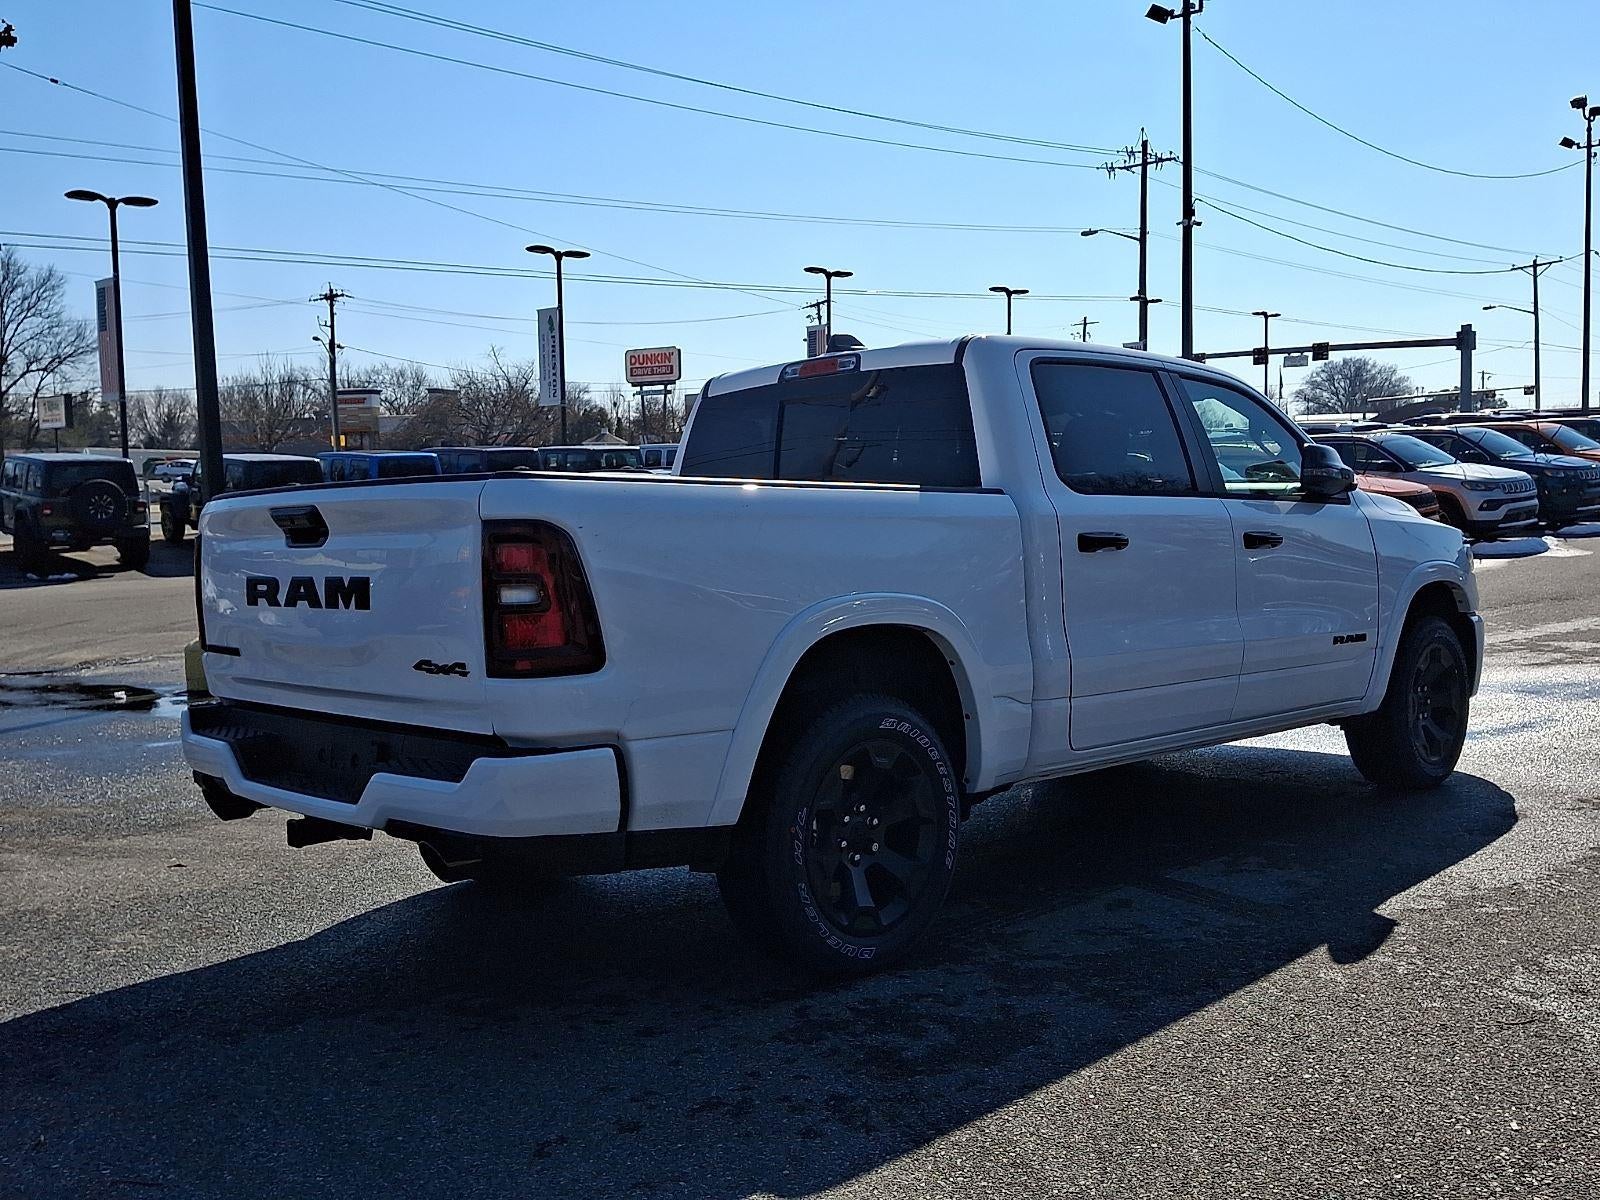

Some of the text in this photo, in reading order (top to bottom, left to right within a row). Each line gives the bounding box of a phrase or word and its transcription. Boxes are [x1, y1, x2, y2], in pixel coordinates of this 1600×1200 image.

[630, 352, 674, 366] DUNKIN'
[632, 367, 671, 376] DRIVE THRU
[246, 576, 371, 610] RAM
[1333, 633, 1367, 645] RAM
[879, 717, 958, 870] BRIDGESTONE
[798, 882, 877, 959] DUELER
